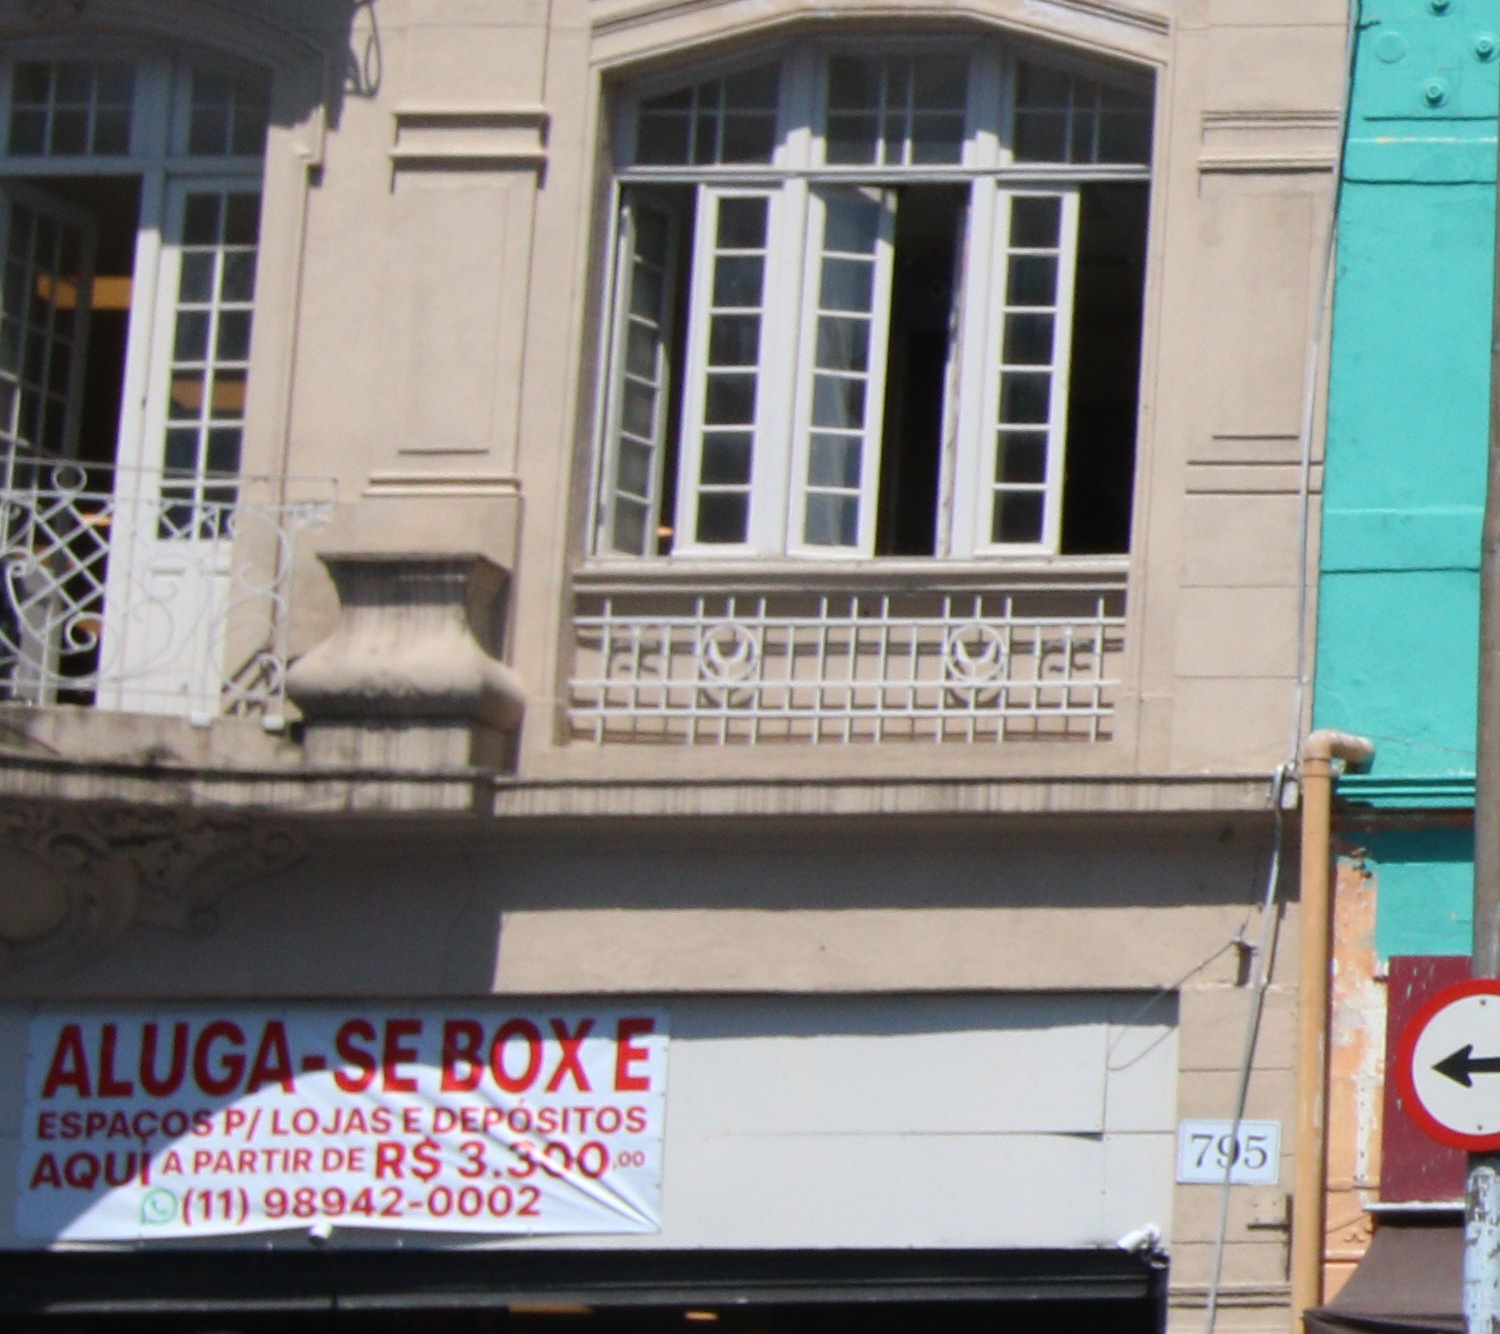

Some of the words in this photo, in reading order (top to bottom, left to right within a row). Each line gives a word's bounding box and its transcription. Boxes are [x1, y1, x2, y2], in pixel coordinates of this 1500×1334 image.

[41, 1019, 423, 1099] ALUGA-SE
[440, 1017, 594, 1093] BOX
[613, 1017, 656, 1092] E
[37, 1107, 214, 1145] ESPAÇOS
[223, 1108, 262, 1144] P/
[271, 1106, 390, 1137] LOJAS
[402, 1106, 423, 1135] E
[431, 1095, 648, 1135] DEPÓSITOS
[30, 1151, 151, 1192] AQUI
[162, 1150, 184, 1176] A
[191, 1148, 311, 1175] PARTIR
[322, 1147, 366, 1172] DE
[374, 1139, 441, 1182] R$
[1190, 1131, 1268, 1173] 795
[182, 1188, 250, 1225] (11)
[263, 1185, 541, 1220] 98942-0002
